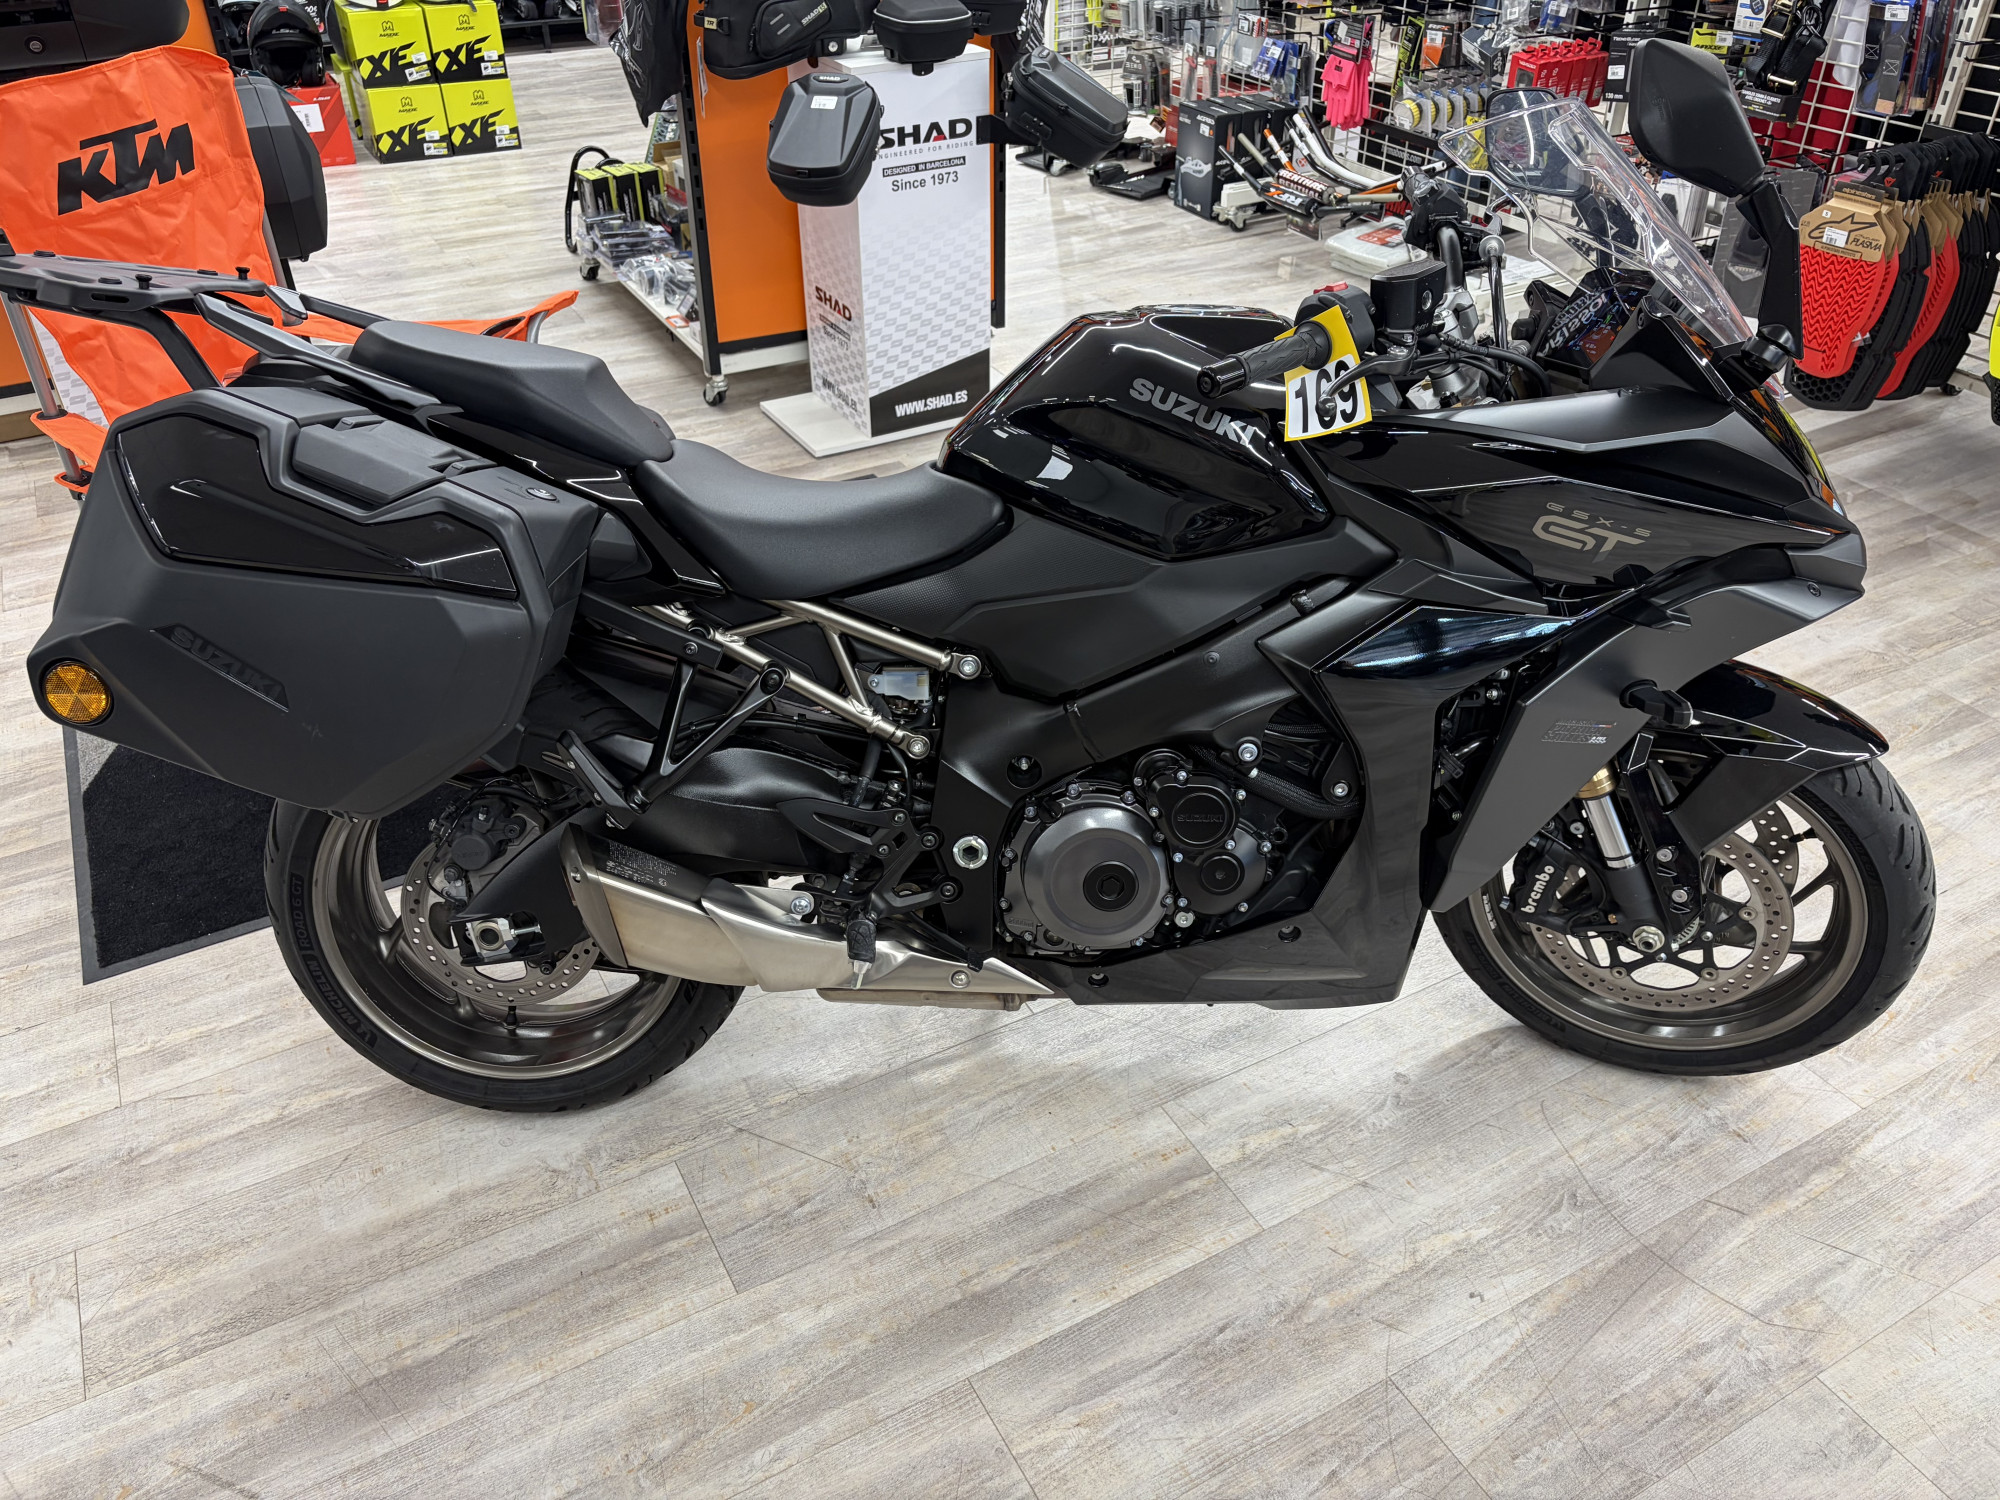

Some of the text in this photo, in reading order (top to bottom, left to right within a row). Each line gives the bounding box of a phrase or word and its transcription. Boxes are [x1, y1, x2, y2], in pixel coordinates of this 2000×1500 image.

[874, 148, 924, 161] NGINEERED
[946, 140, 975, 149] RIDING
[879, 117, 974, 151] SHAD
[57, 118, 196, 216] KTM
[883, 157, 966, 177] DESIGNED IN BARCELONA
[891, 170, 959, 192] Since 1973
[1849, 237, 1883, 252] PLASMA
[815, 285, 853, 322] SHAD
[894, 389, 969, 418] WWW.SHAD.ES
[1129, 377, 1258, 446] SUZUKI
[170, 626, 282, 702] SUZUKI
[1176, 813, 1224, 823] SUZUKI
[1520, 865, 1555, 914] brembo
[306, 959, 358, 1028] MICHELIN
